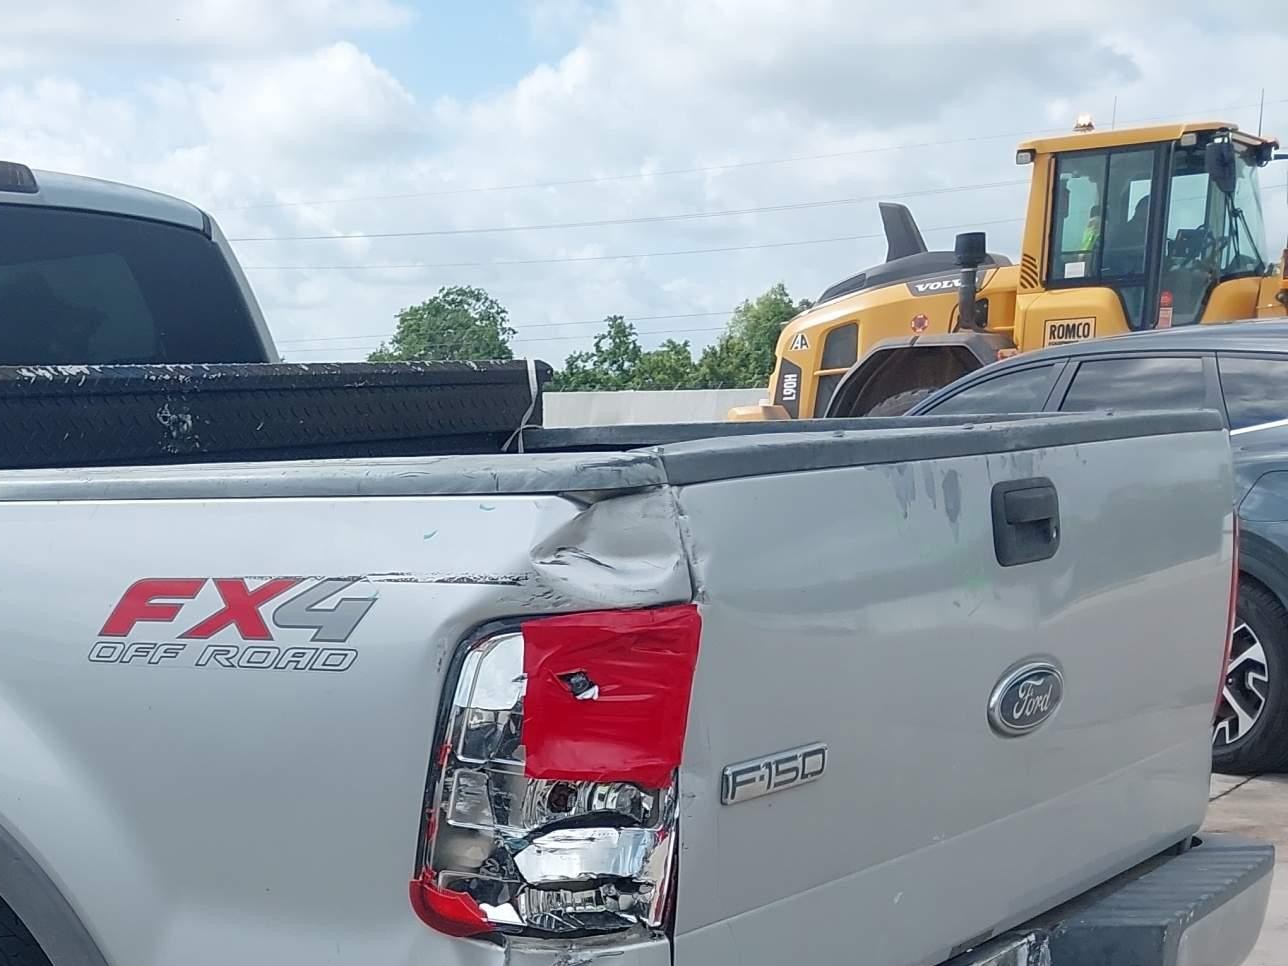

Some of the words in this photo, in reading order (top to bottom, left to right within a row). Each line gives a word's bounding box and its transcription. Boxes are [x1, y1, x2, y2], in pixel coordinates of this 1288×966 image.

[915, 279, 963, 292] VOLV
[1049, 322, 1090, 340] ROMCO
[782, 373, 798, 401] L90H
[97, 576, 379, 643] FX4
[88, 641, 186, 665] OFF
[195, 644, 358, 672] ROAD
[1013, 678, 1053, 719] Ford
